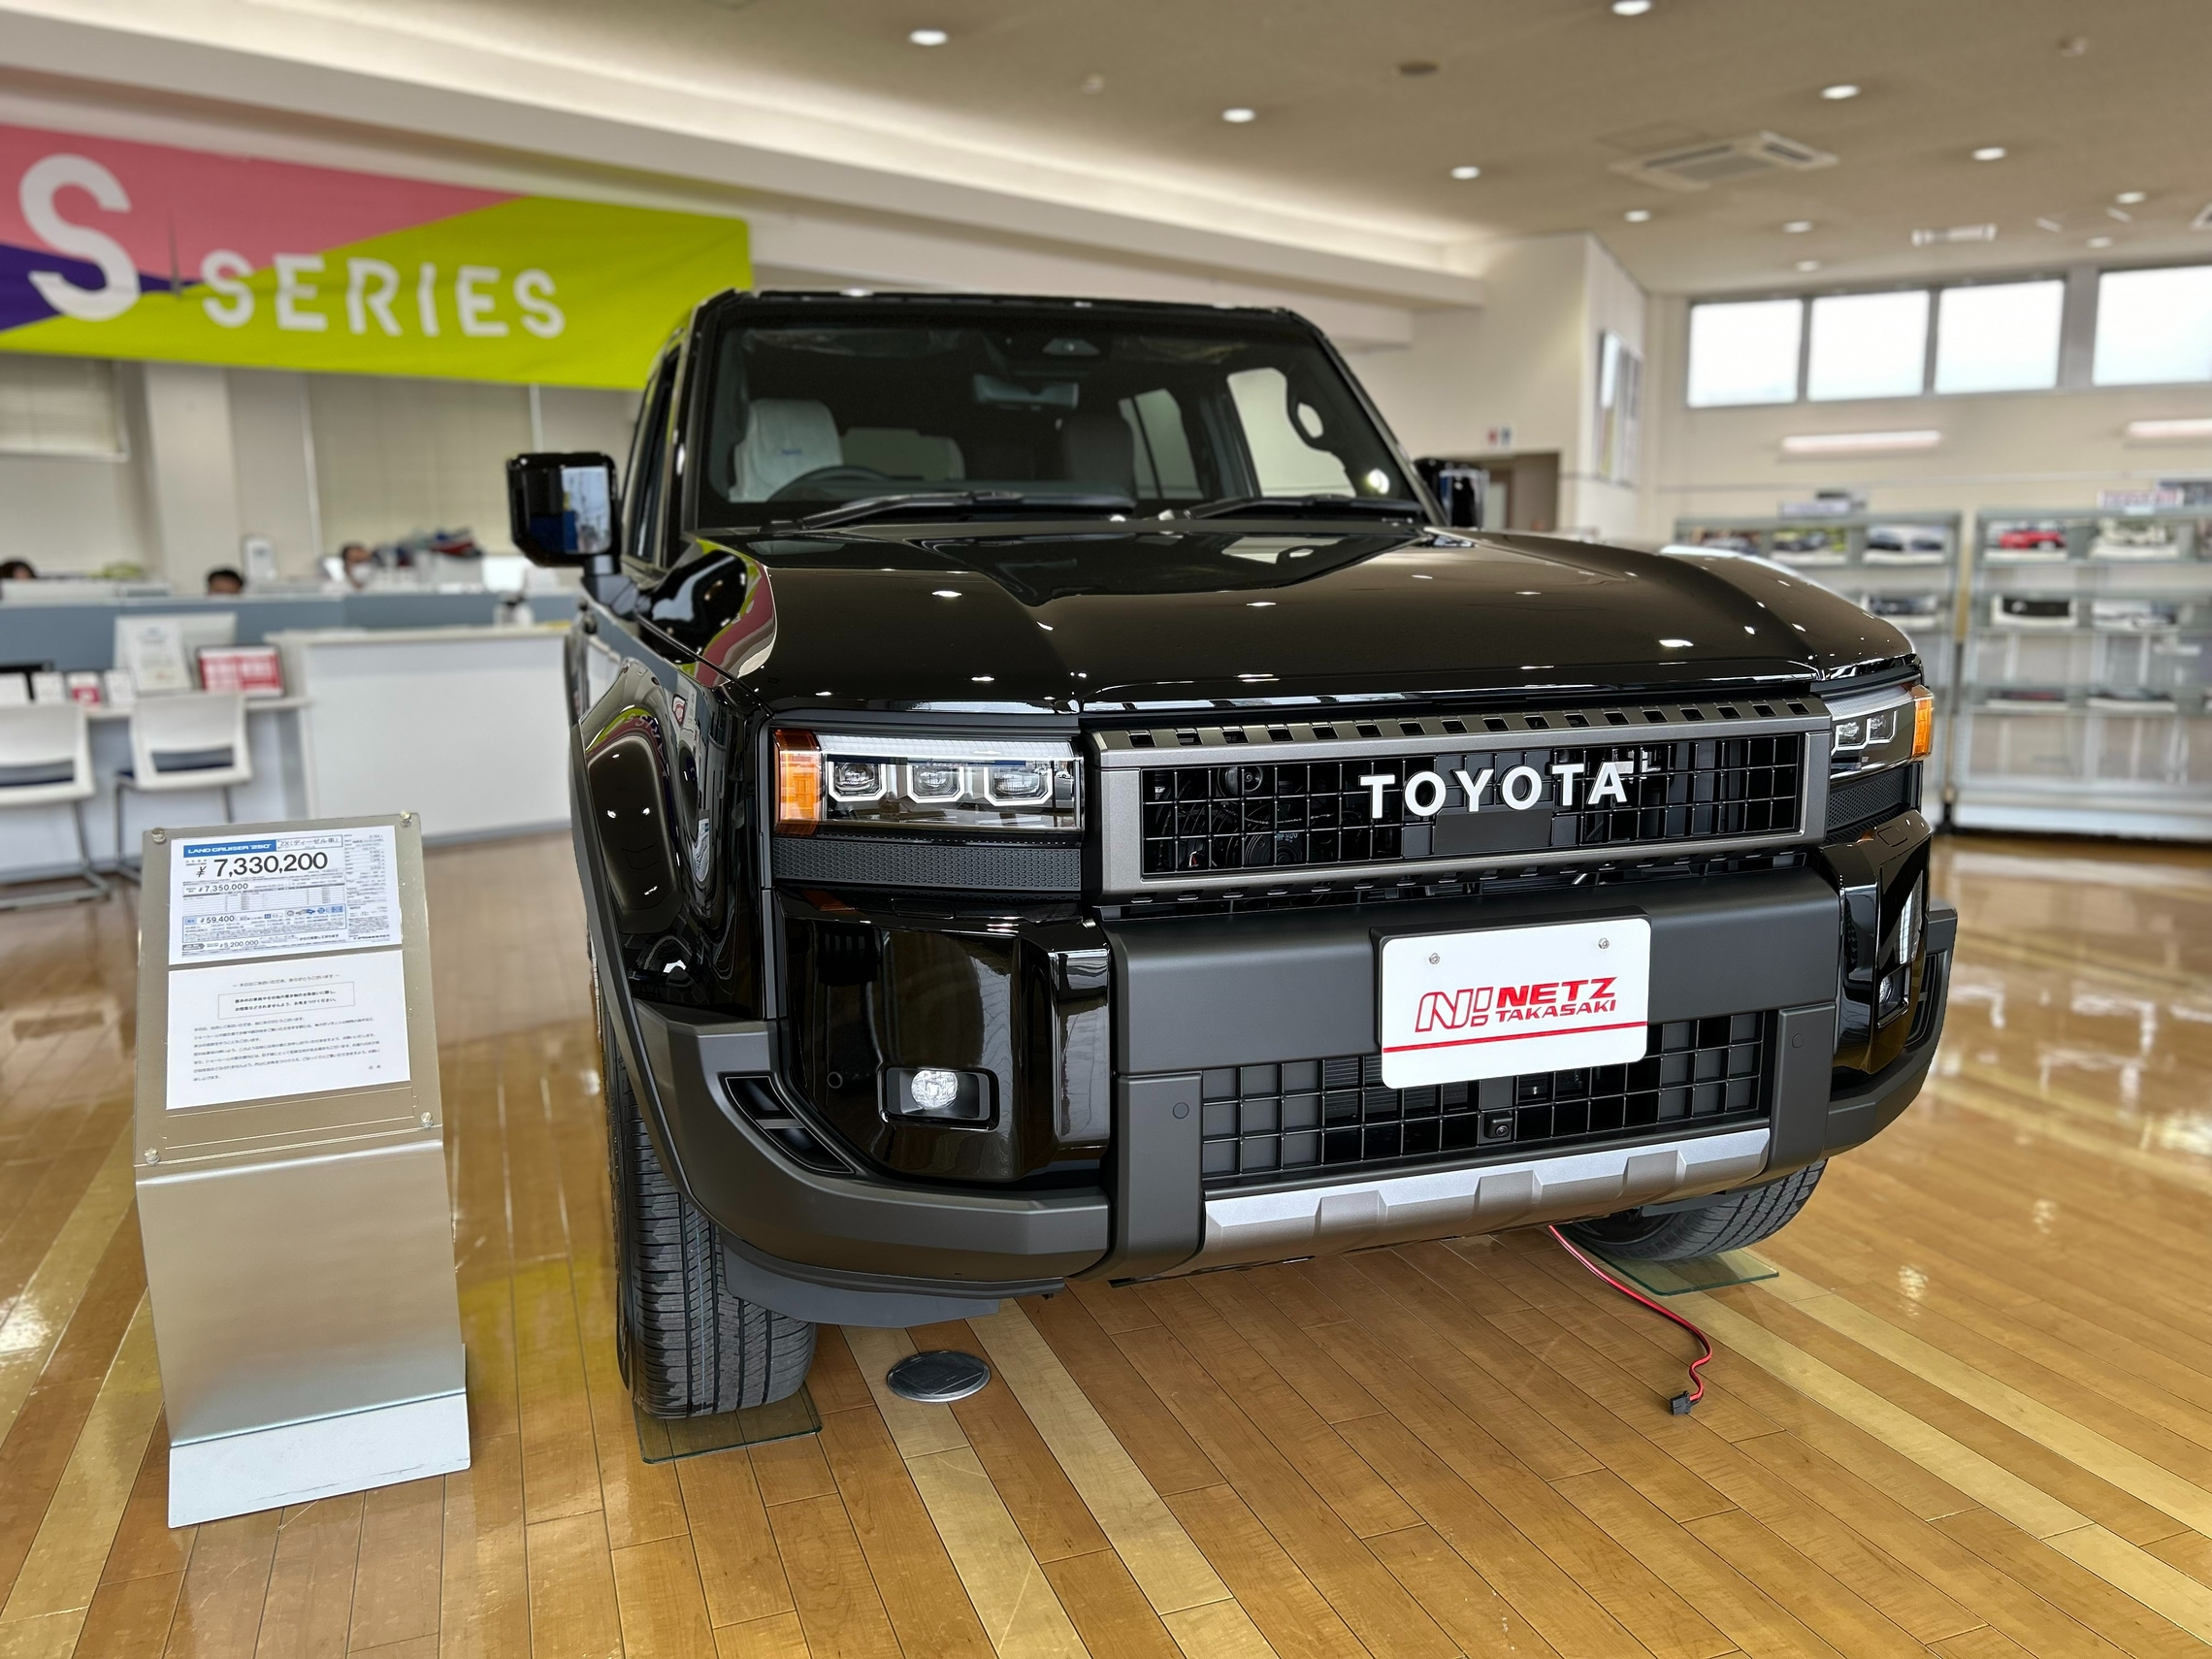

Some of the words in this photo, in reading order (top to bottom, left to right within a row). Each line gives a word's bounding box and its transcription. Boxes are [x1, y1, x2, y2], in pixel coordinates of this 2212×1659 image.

[18, 152, 140, 321] S
[200, 248, 566, 340] SERIES
[1359, 762, 1627, 819] TOYOTA
[213, 852, 329, 878] 7,330,200
[1497, 977, 1618, 1008] NETZ
[1495, 999, 1617, 1023] TAKASAKI
